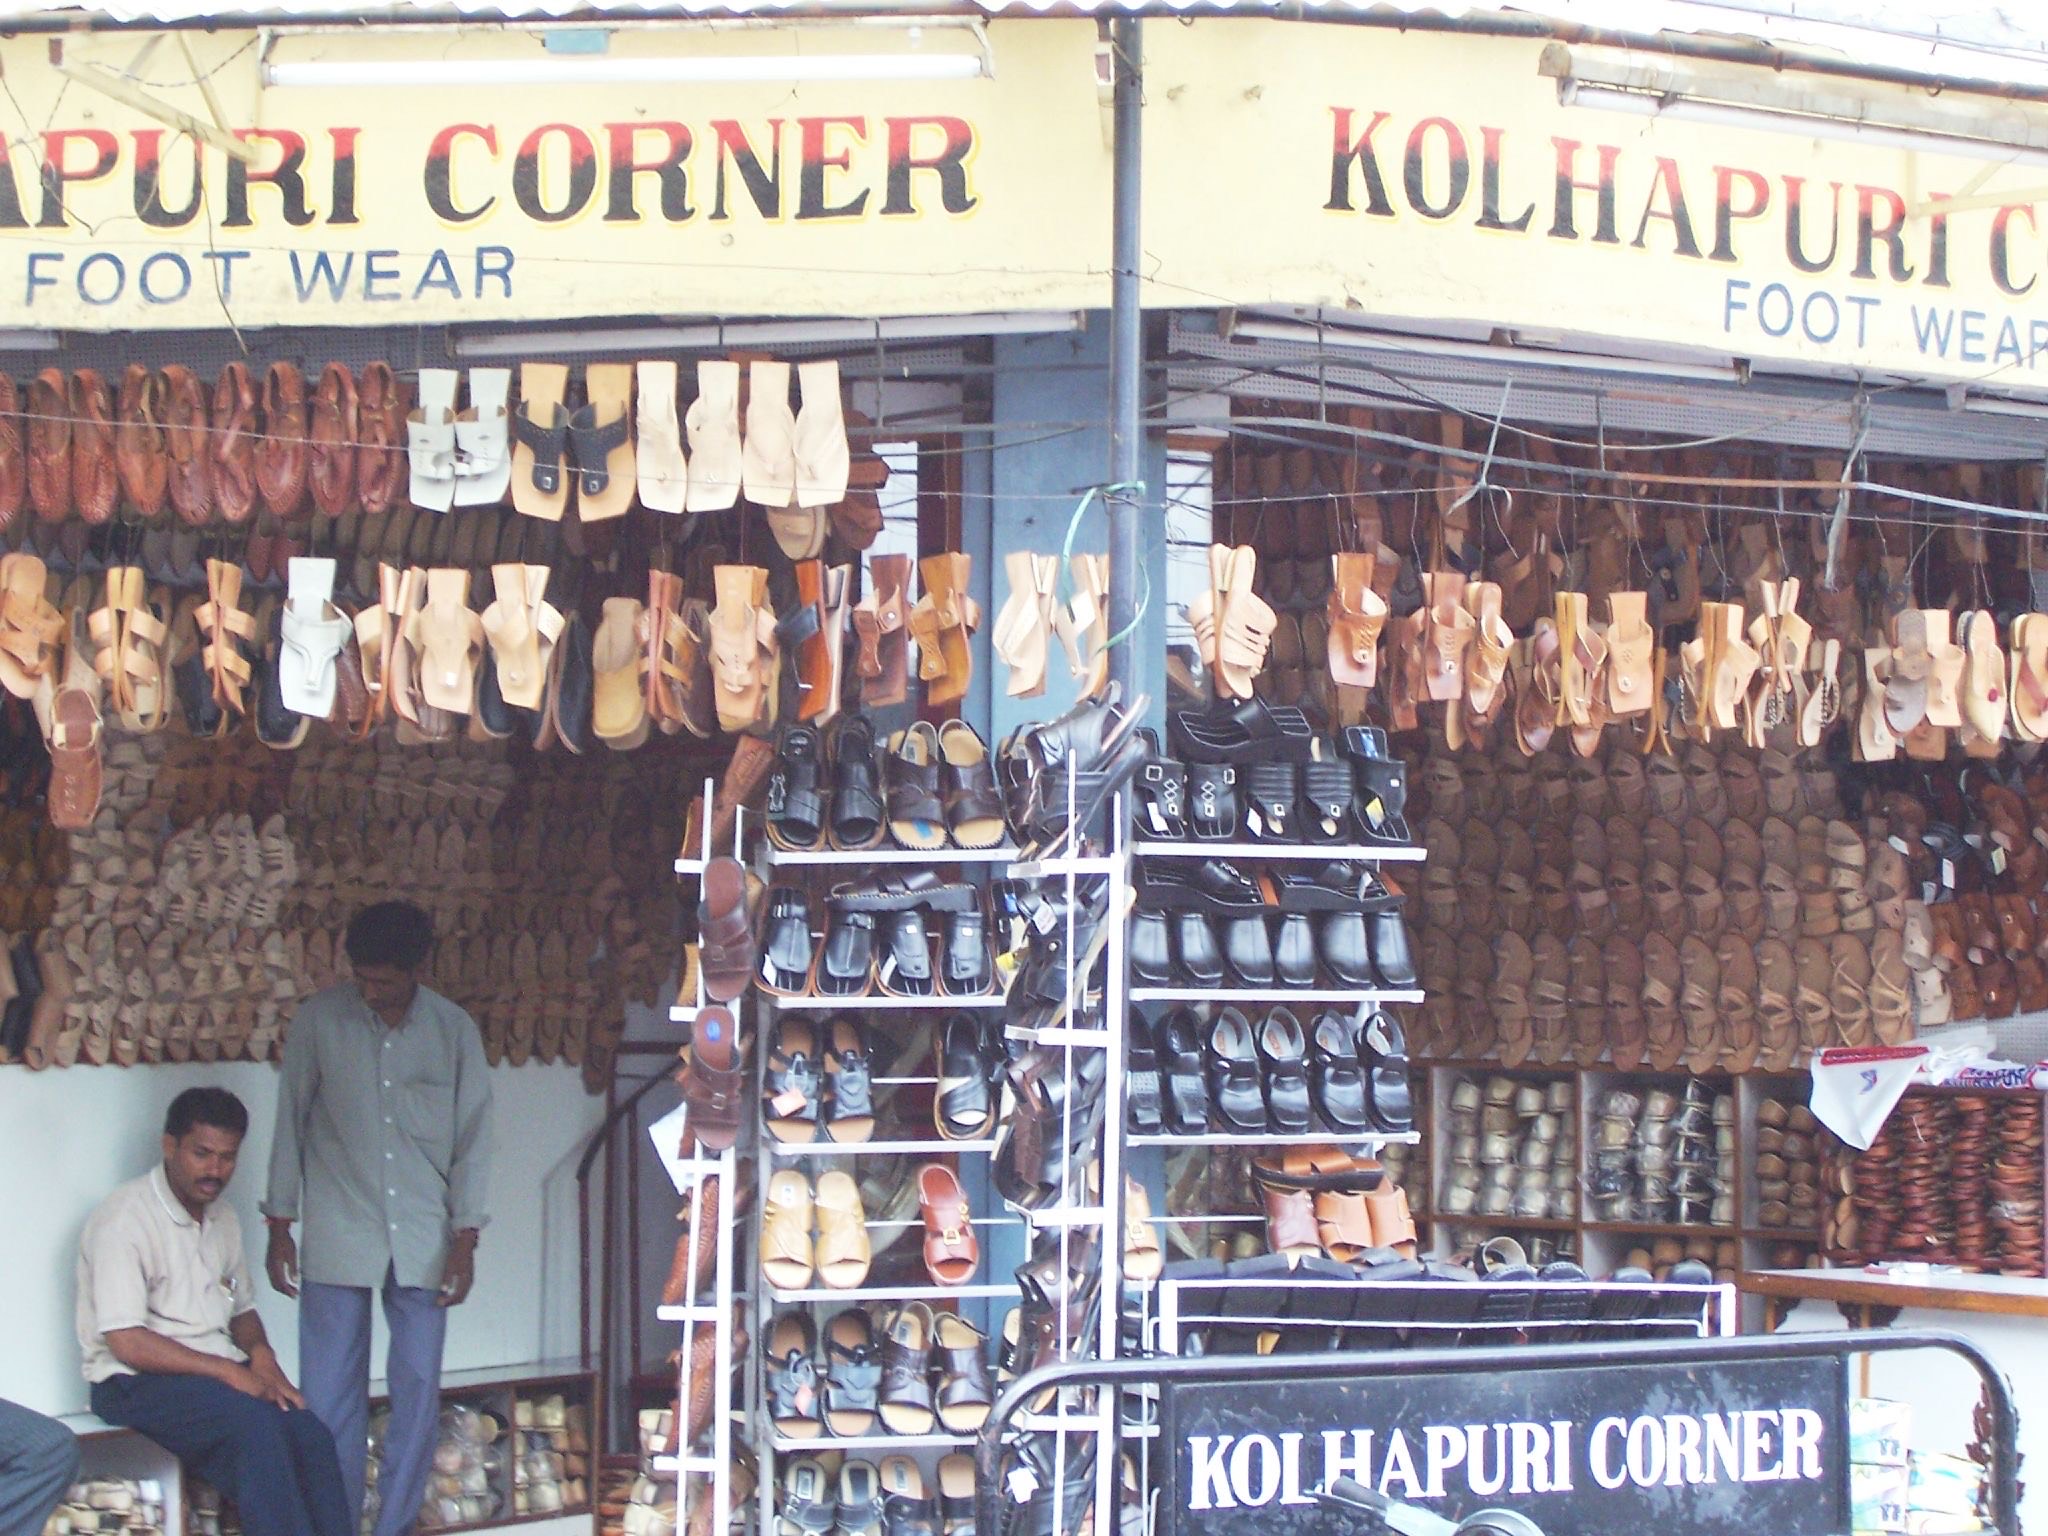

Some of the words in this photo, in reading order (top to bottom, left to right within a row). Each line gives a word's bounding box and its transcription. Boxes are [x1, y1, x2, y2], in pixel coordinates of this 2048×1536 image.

[423, 115, 978, 224] CORNER
[1322, 105, 1952, 287] KOLHAPURI
[1988, 202, 2048, 296] C
[26, 251, 250, 306] FOOT
[289, 246, 516, 301] WEAR
[1723, 278, 1882, 348] FOOT
[1910, 304, 2048, 370] WEAR
[1187, 1420, 1573, 1511] KOLHAPURI
[1589, 1408, 1824, 1490] CORNER
